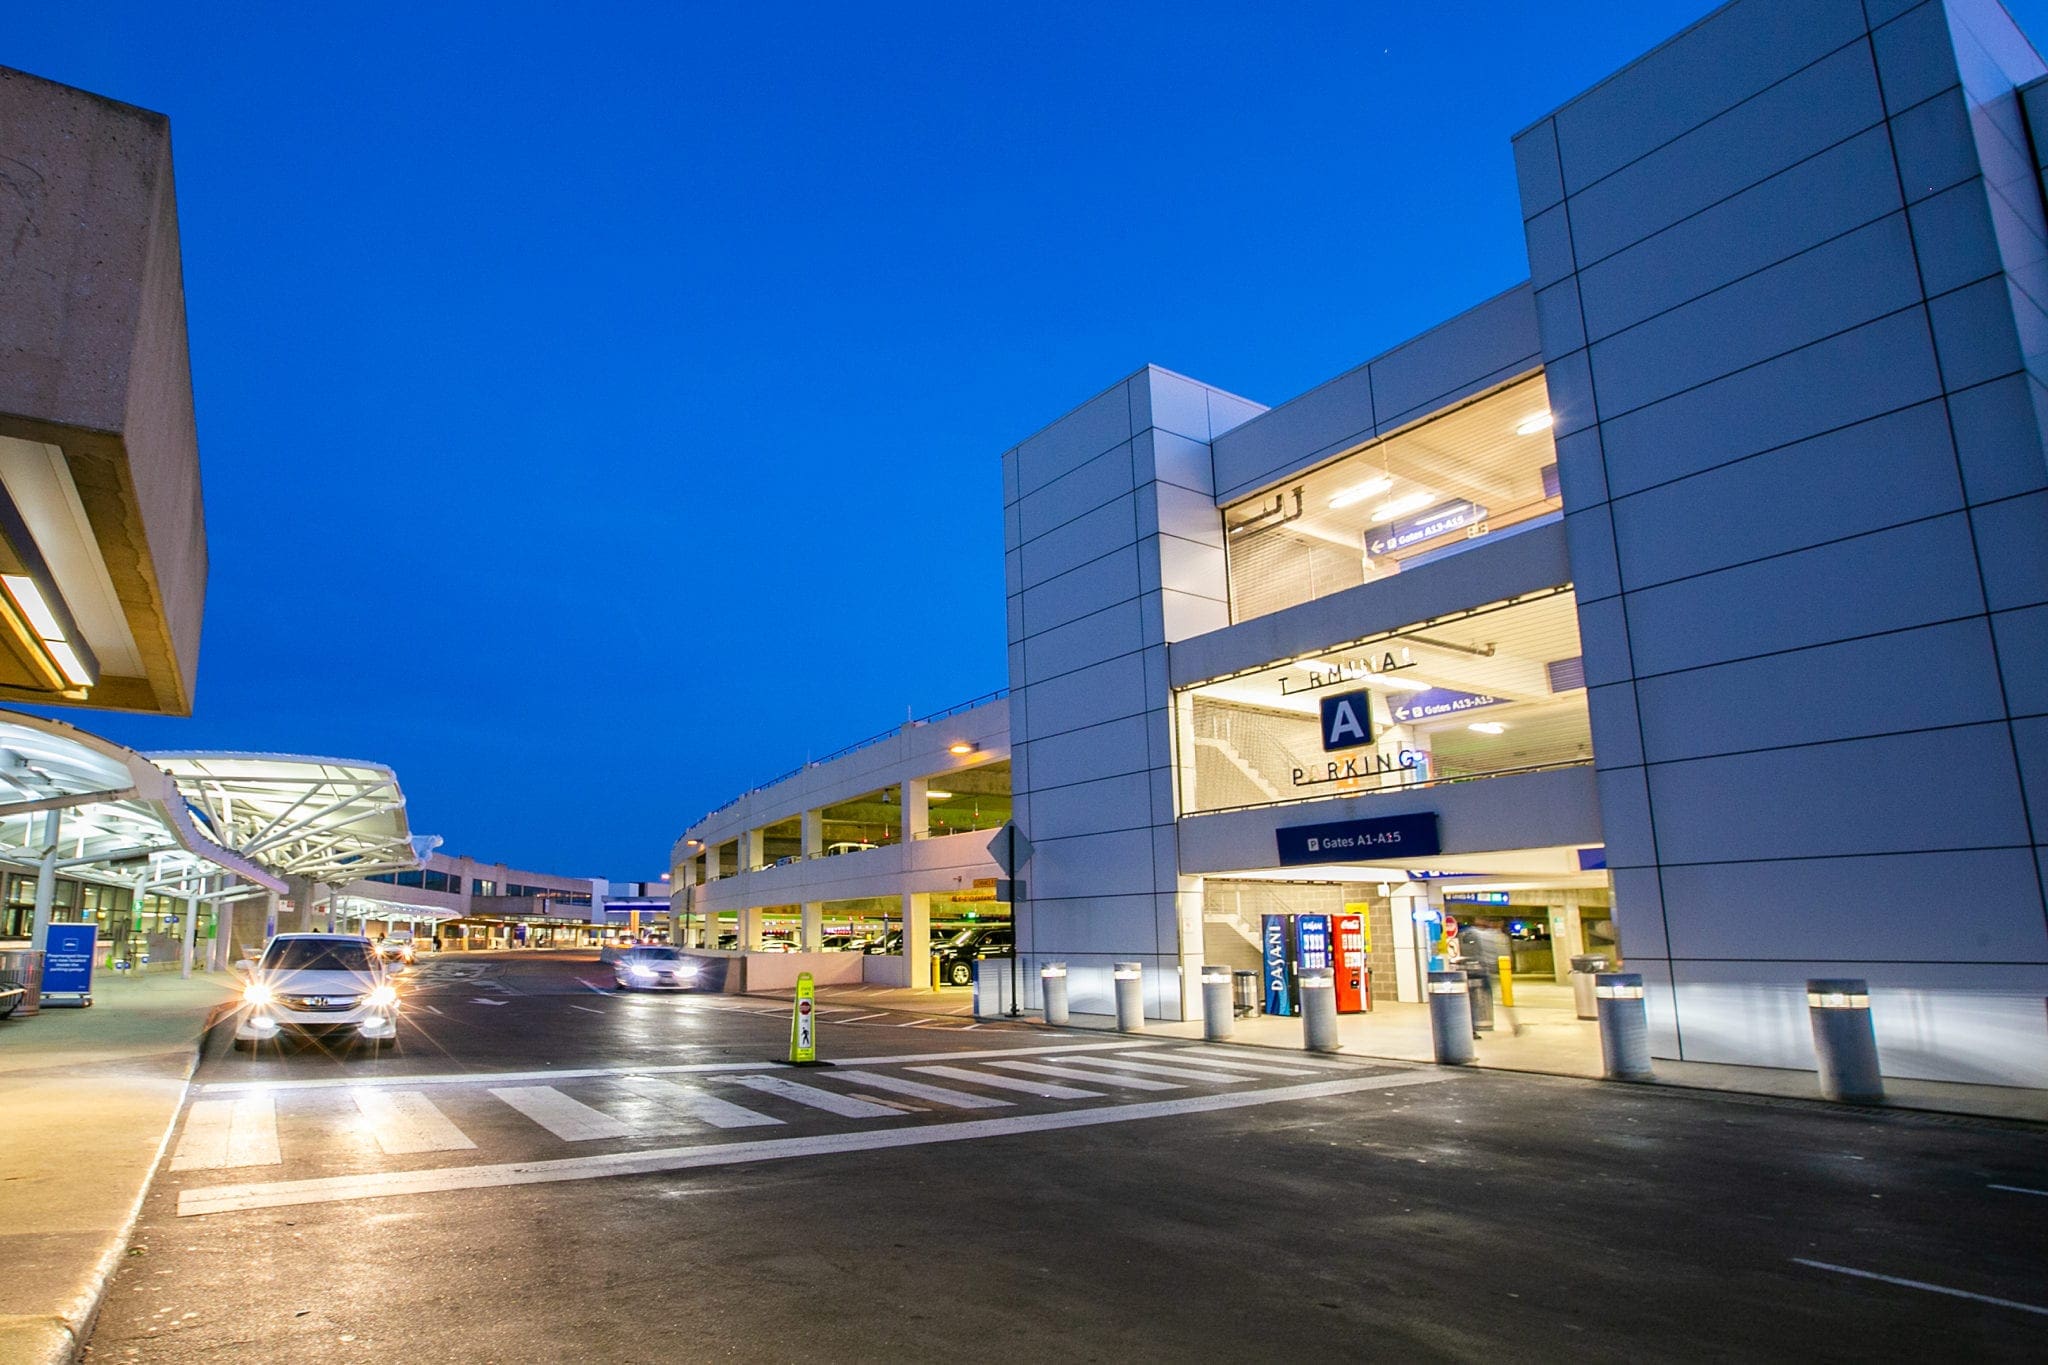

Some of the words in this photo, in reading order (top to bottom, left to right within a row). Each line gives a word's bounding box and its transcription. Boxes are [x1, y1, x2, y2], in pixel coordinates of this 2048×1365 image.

[1278, 646, 1413, 695] TRMINAL
[1330, 700, 1365, 743] A
[1322, 837, 1355, 850] Gates
[1357, 831, 1402, 846] A1-A15
[1267, 925, 1286, 991] DASANI
